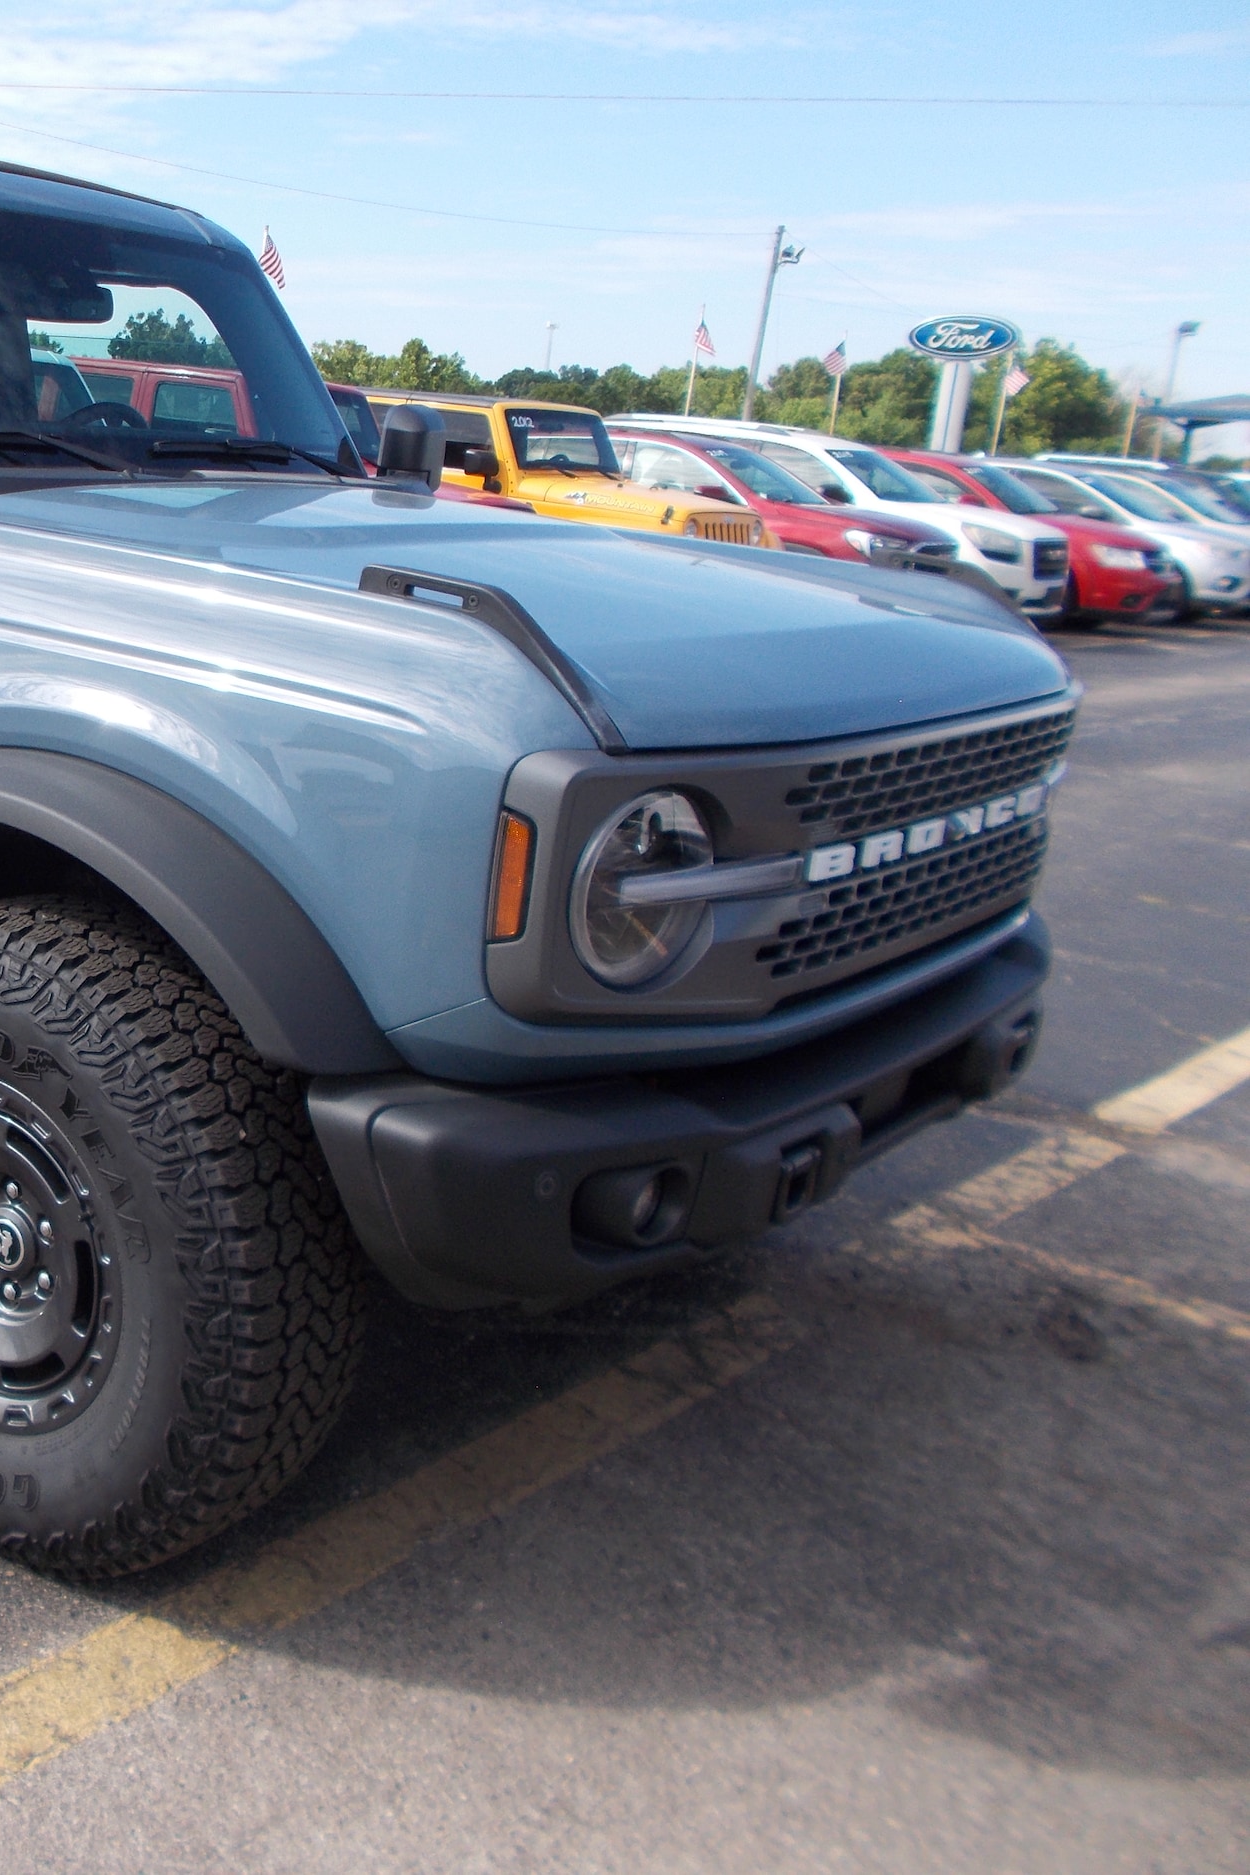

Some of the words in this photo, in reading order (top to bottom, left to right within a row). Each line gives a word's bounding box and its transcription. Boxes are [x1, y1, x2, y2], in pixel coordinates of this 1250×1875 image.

[927, 321, 995, 349] Ford
[511, 415, 535, 428] 2012
[584, 493, 655, 514] MOUNTAIN
[808, 785, 1046, 881] BRONCO
